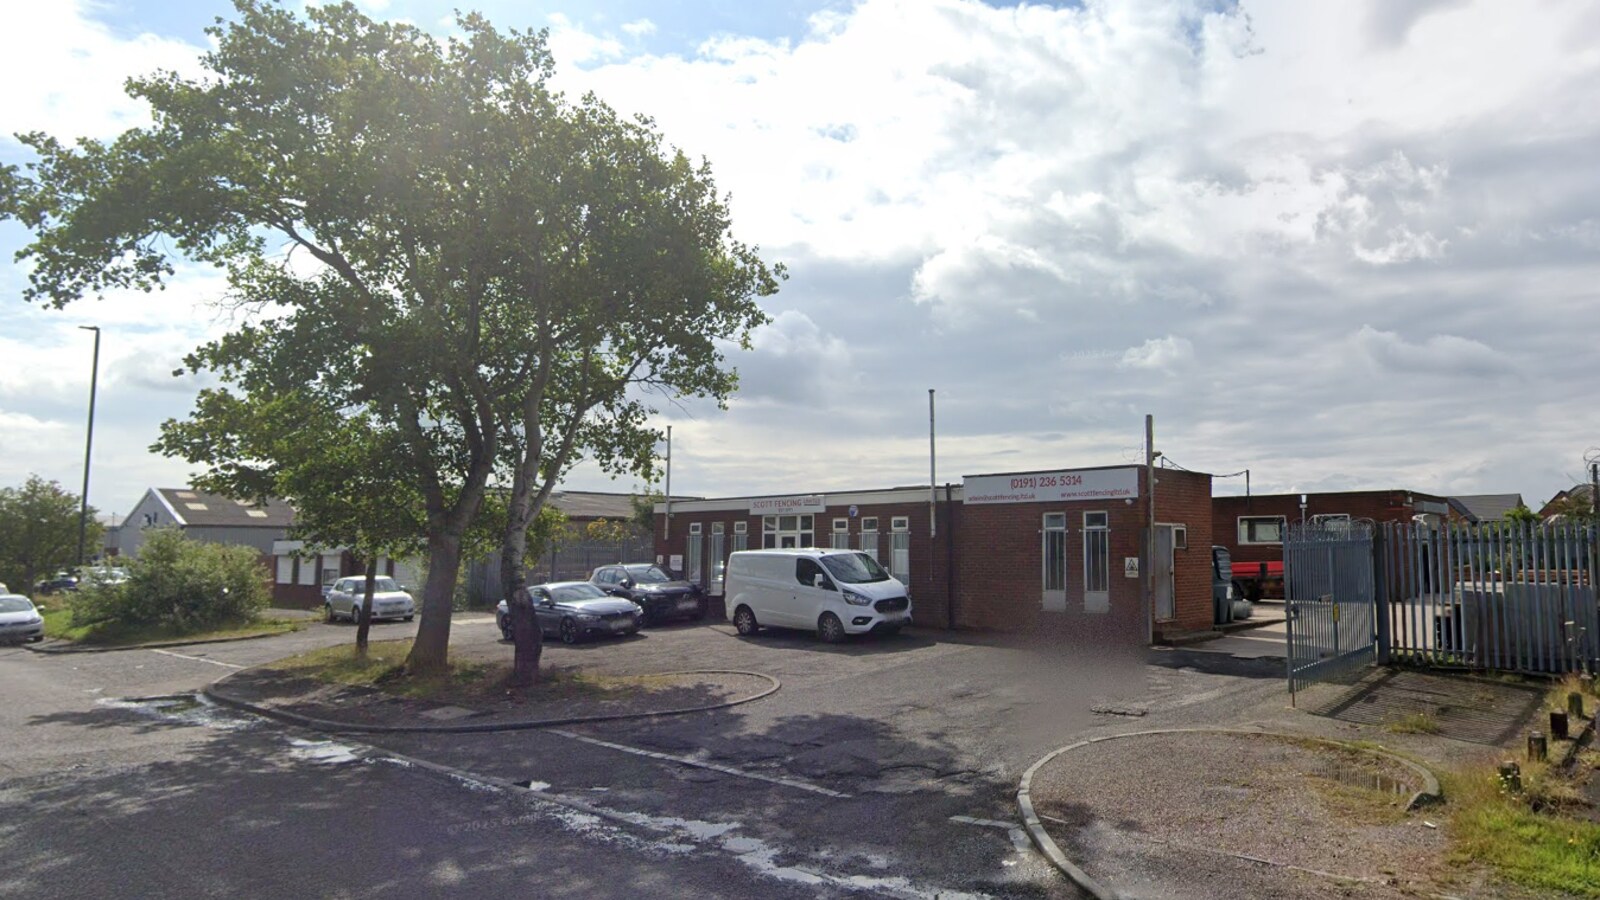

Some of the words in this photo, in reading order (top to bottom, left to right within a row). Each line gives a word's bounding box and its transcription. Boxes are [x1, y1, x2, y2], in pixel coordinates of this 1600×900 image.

[1010, 477, 1037, 490] (0191)
[1039, 476, 1057, 488] 236
[1059, 475, 1083, 487] 5314
[752, 500, 773, 509] SCOTT
[774, 498, 802, 508] FENCING
